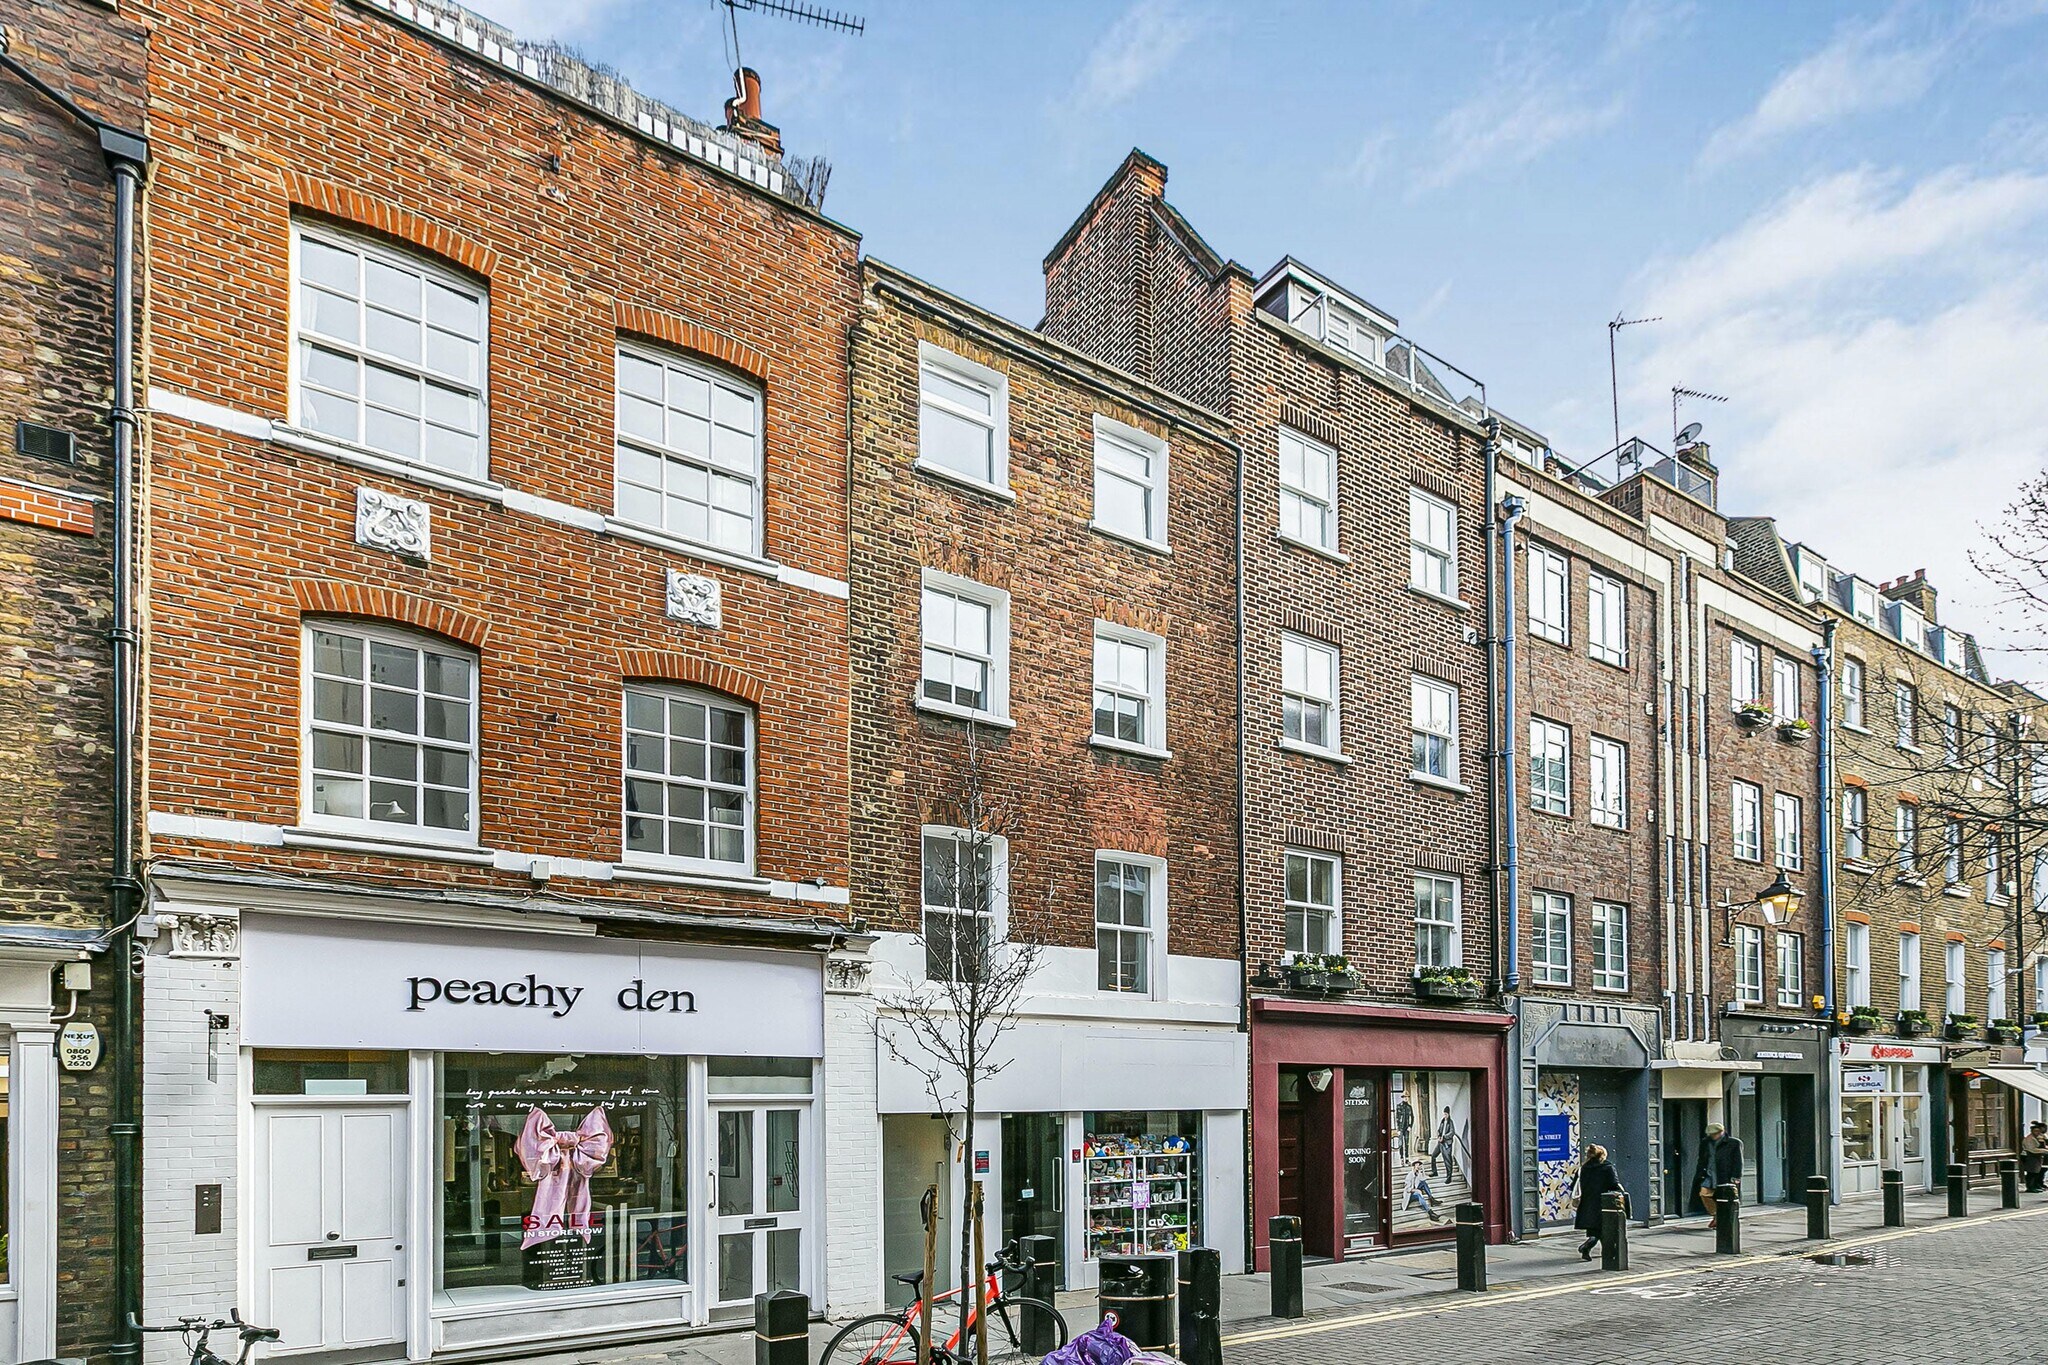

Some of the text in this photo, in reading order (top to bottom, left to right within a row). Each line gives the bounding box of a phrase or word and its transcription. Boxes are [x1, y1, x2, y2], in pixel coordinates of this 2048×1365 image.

[406, 974, 698, 1017] peachy den
[466, 1088, 483, 1100] hey
[581, 1088, 595, 1096] for
[612, 1086, 633, 1100] good
[516, 1101, 534, 1112] long
[522, 1213, 604, 1230] SALE
[538, 1229, 573, 1237] STORE
